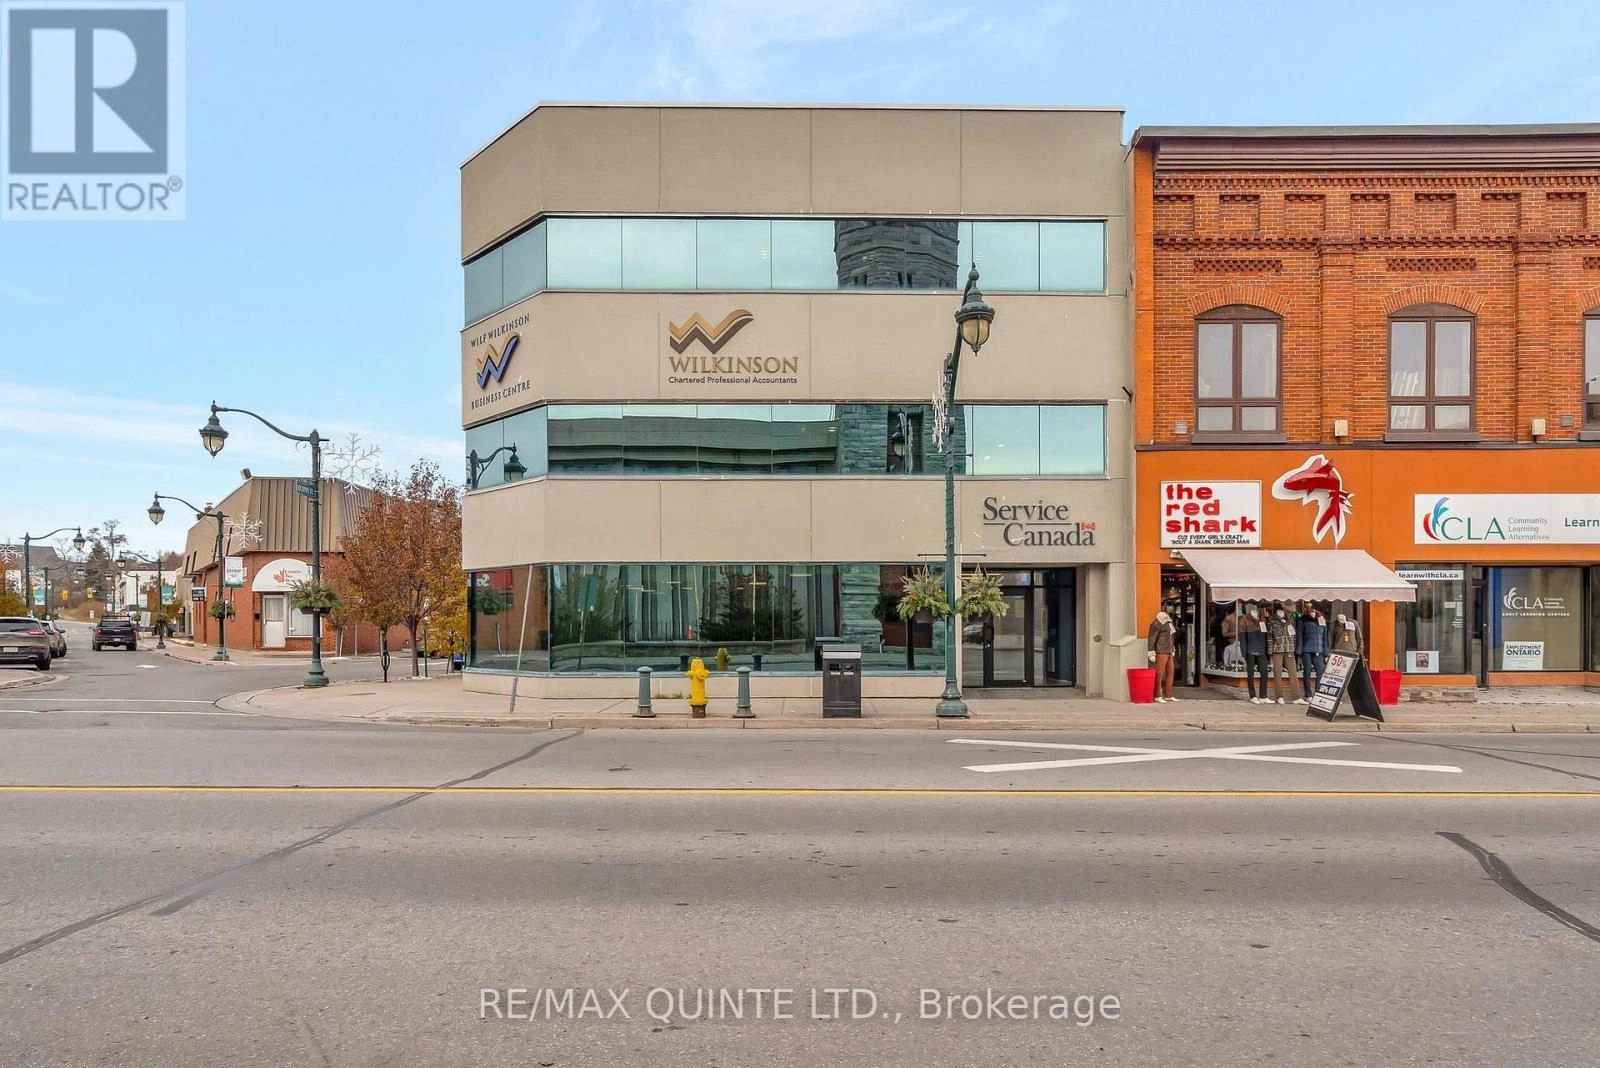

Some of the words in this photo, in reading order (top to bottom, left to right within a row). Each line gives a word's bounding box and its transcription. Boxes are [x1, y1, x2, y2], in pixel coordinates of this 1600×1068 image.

[471, 334, 487, 348] WILF
[488, 313, 530, 340] WILKINSON
[668, 356, 799, 374] WILKINSON
[668, 376, 705, 384] Chartered
[707, 376, 751, 384] Professional
[752, 376, 798, 384] Accountants
[471, 390, 492, 410] BUSINESS
[492, 380, 531, 398] CENTRE
[1166, 484, 1213, 500] the
[983, 496, 1069, 521] Service
[1166, 499, 1220, 516] red
[1165, 516, 1257, 533] shark
[1441, 516, 1506, 541] CLA
[1508, 517, 1548, 525] Community
[1508, 525, 1539, 534] Learning
[1003, 522, 1096, 547] Canada
[1508, 533, 1550, 541] Alternatives
[1511, 596, 1544, 610] CLA
